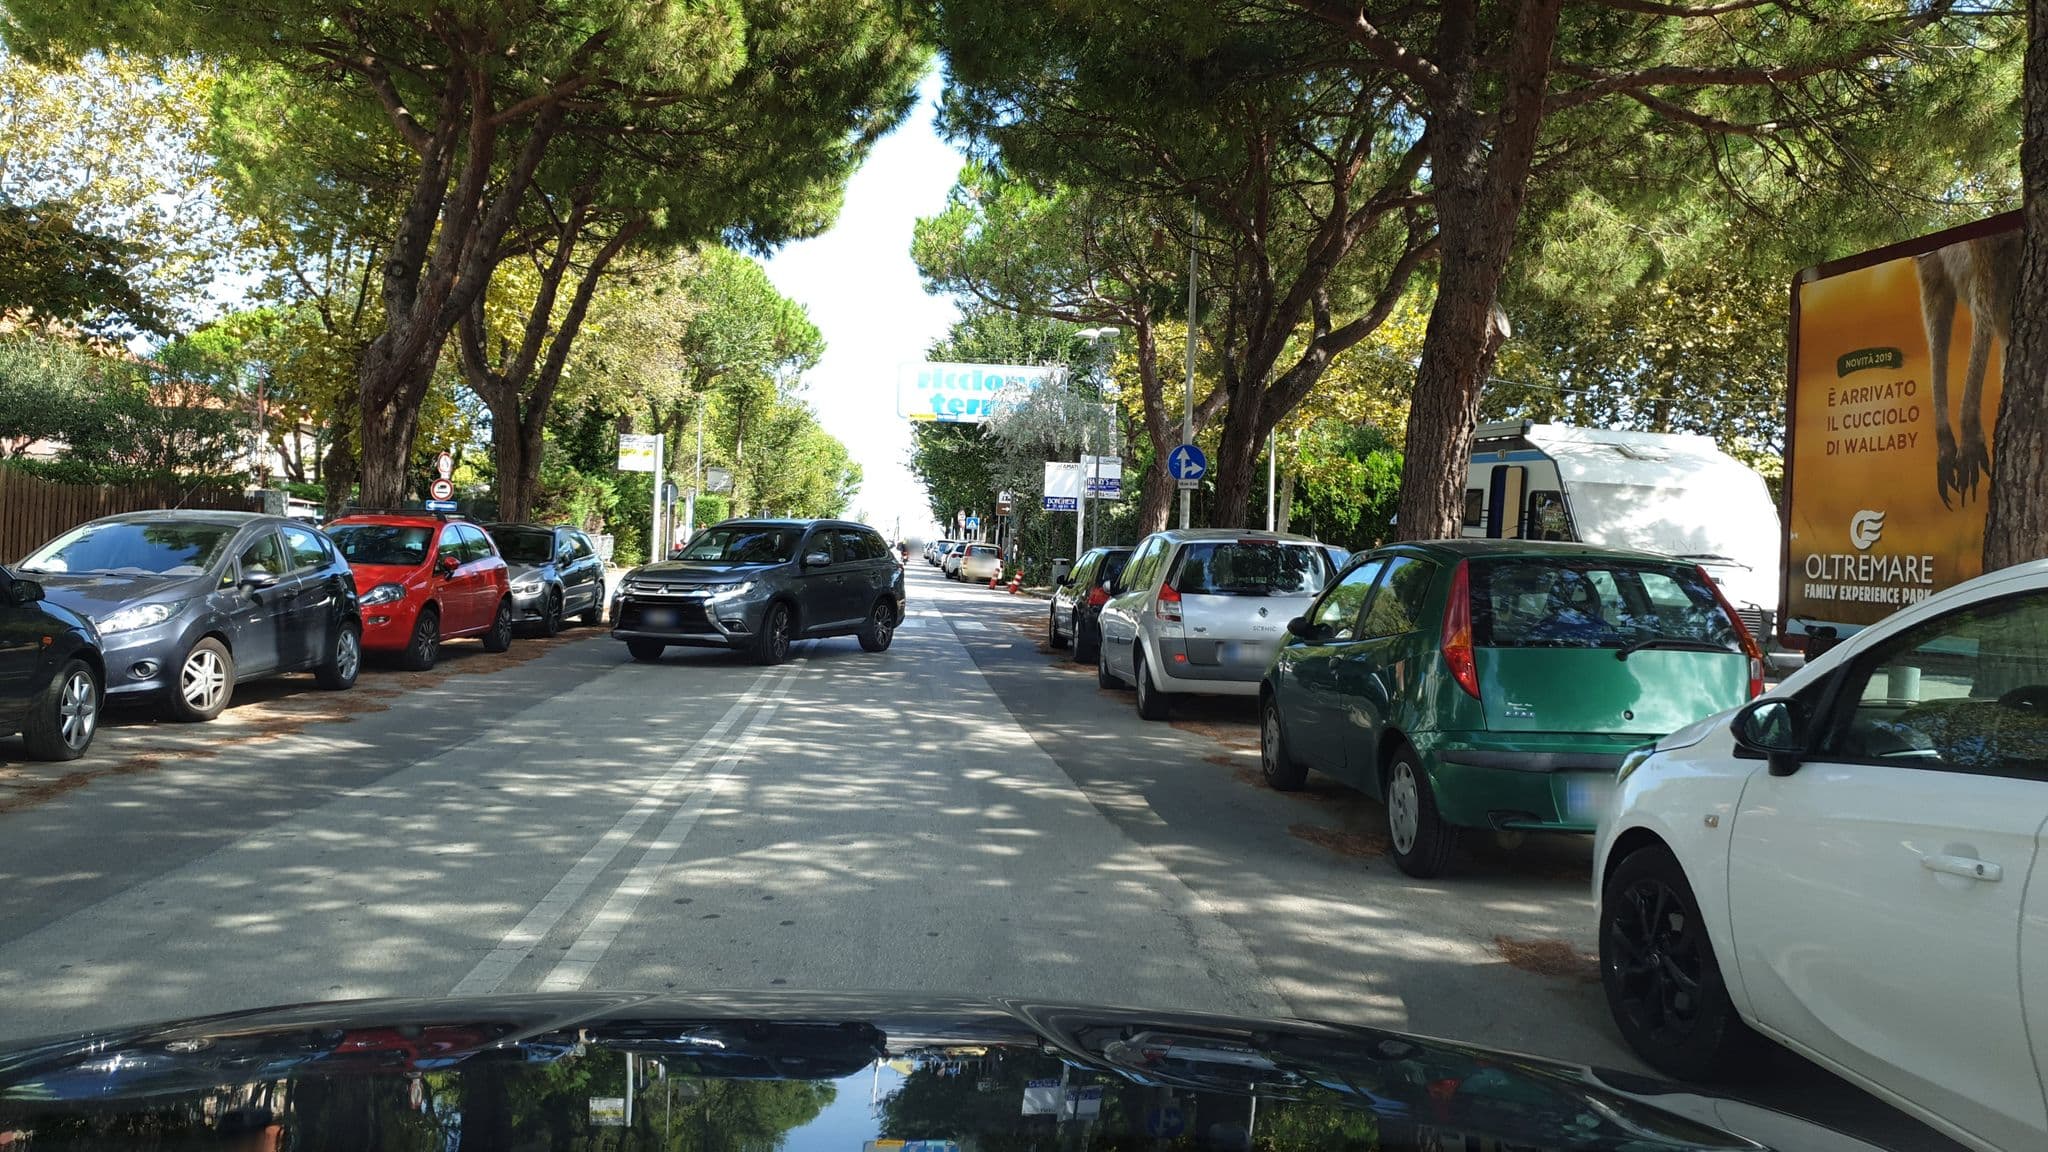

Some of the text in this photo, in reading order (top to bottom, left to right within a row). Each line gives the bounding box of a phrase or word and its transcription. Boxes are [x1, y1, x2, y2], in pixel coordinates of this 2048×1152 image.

[1845, 352, 1893, 368] NOVITÀ 2019
[1839, 379, 1917, 406] ARRIVATO
[1827, 405, 1920, 432] IL CUCCIOLO
[1826, 431, 1919, 456] DI WALLABY
[1804, 553, 1934, 584] OLTREMARE
[1804, 583, 1837, 600] FAMILY
[1839, 585, 1900, 604] EXPERIENCE
